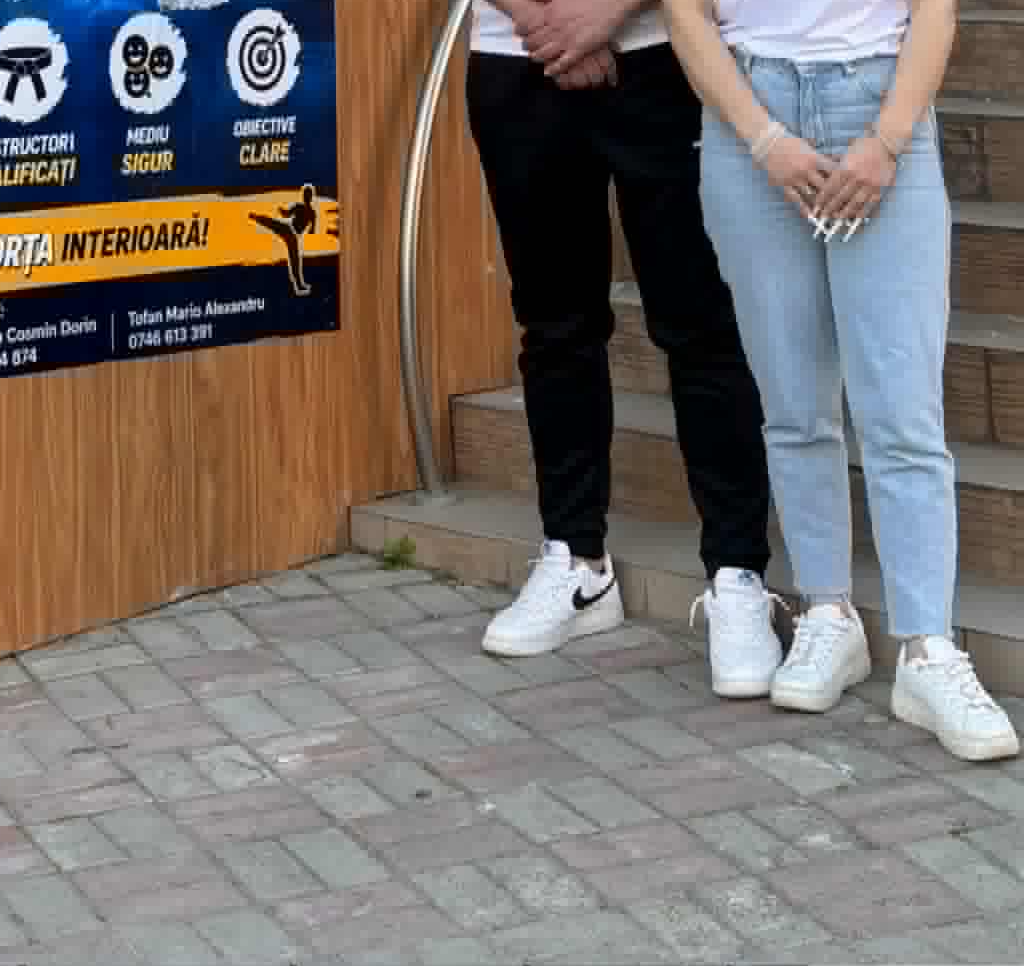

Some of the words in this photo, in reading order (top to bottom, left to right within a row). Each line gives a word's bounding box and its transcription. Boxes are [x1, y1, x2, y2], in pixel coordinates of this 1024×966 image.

[126, 124, 170, 147] MEDIU
[121, 151, 176, 175] SIGUR
[239, 138, 292, 166] CLARE
[62, 212, 211, 263] INTERIOARĂ!
